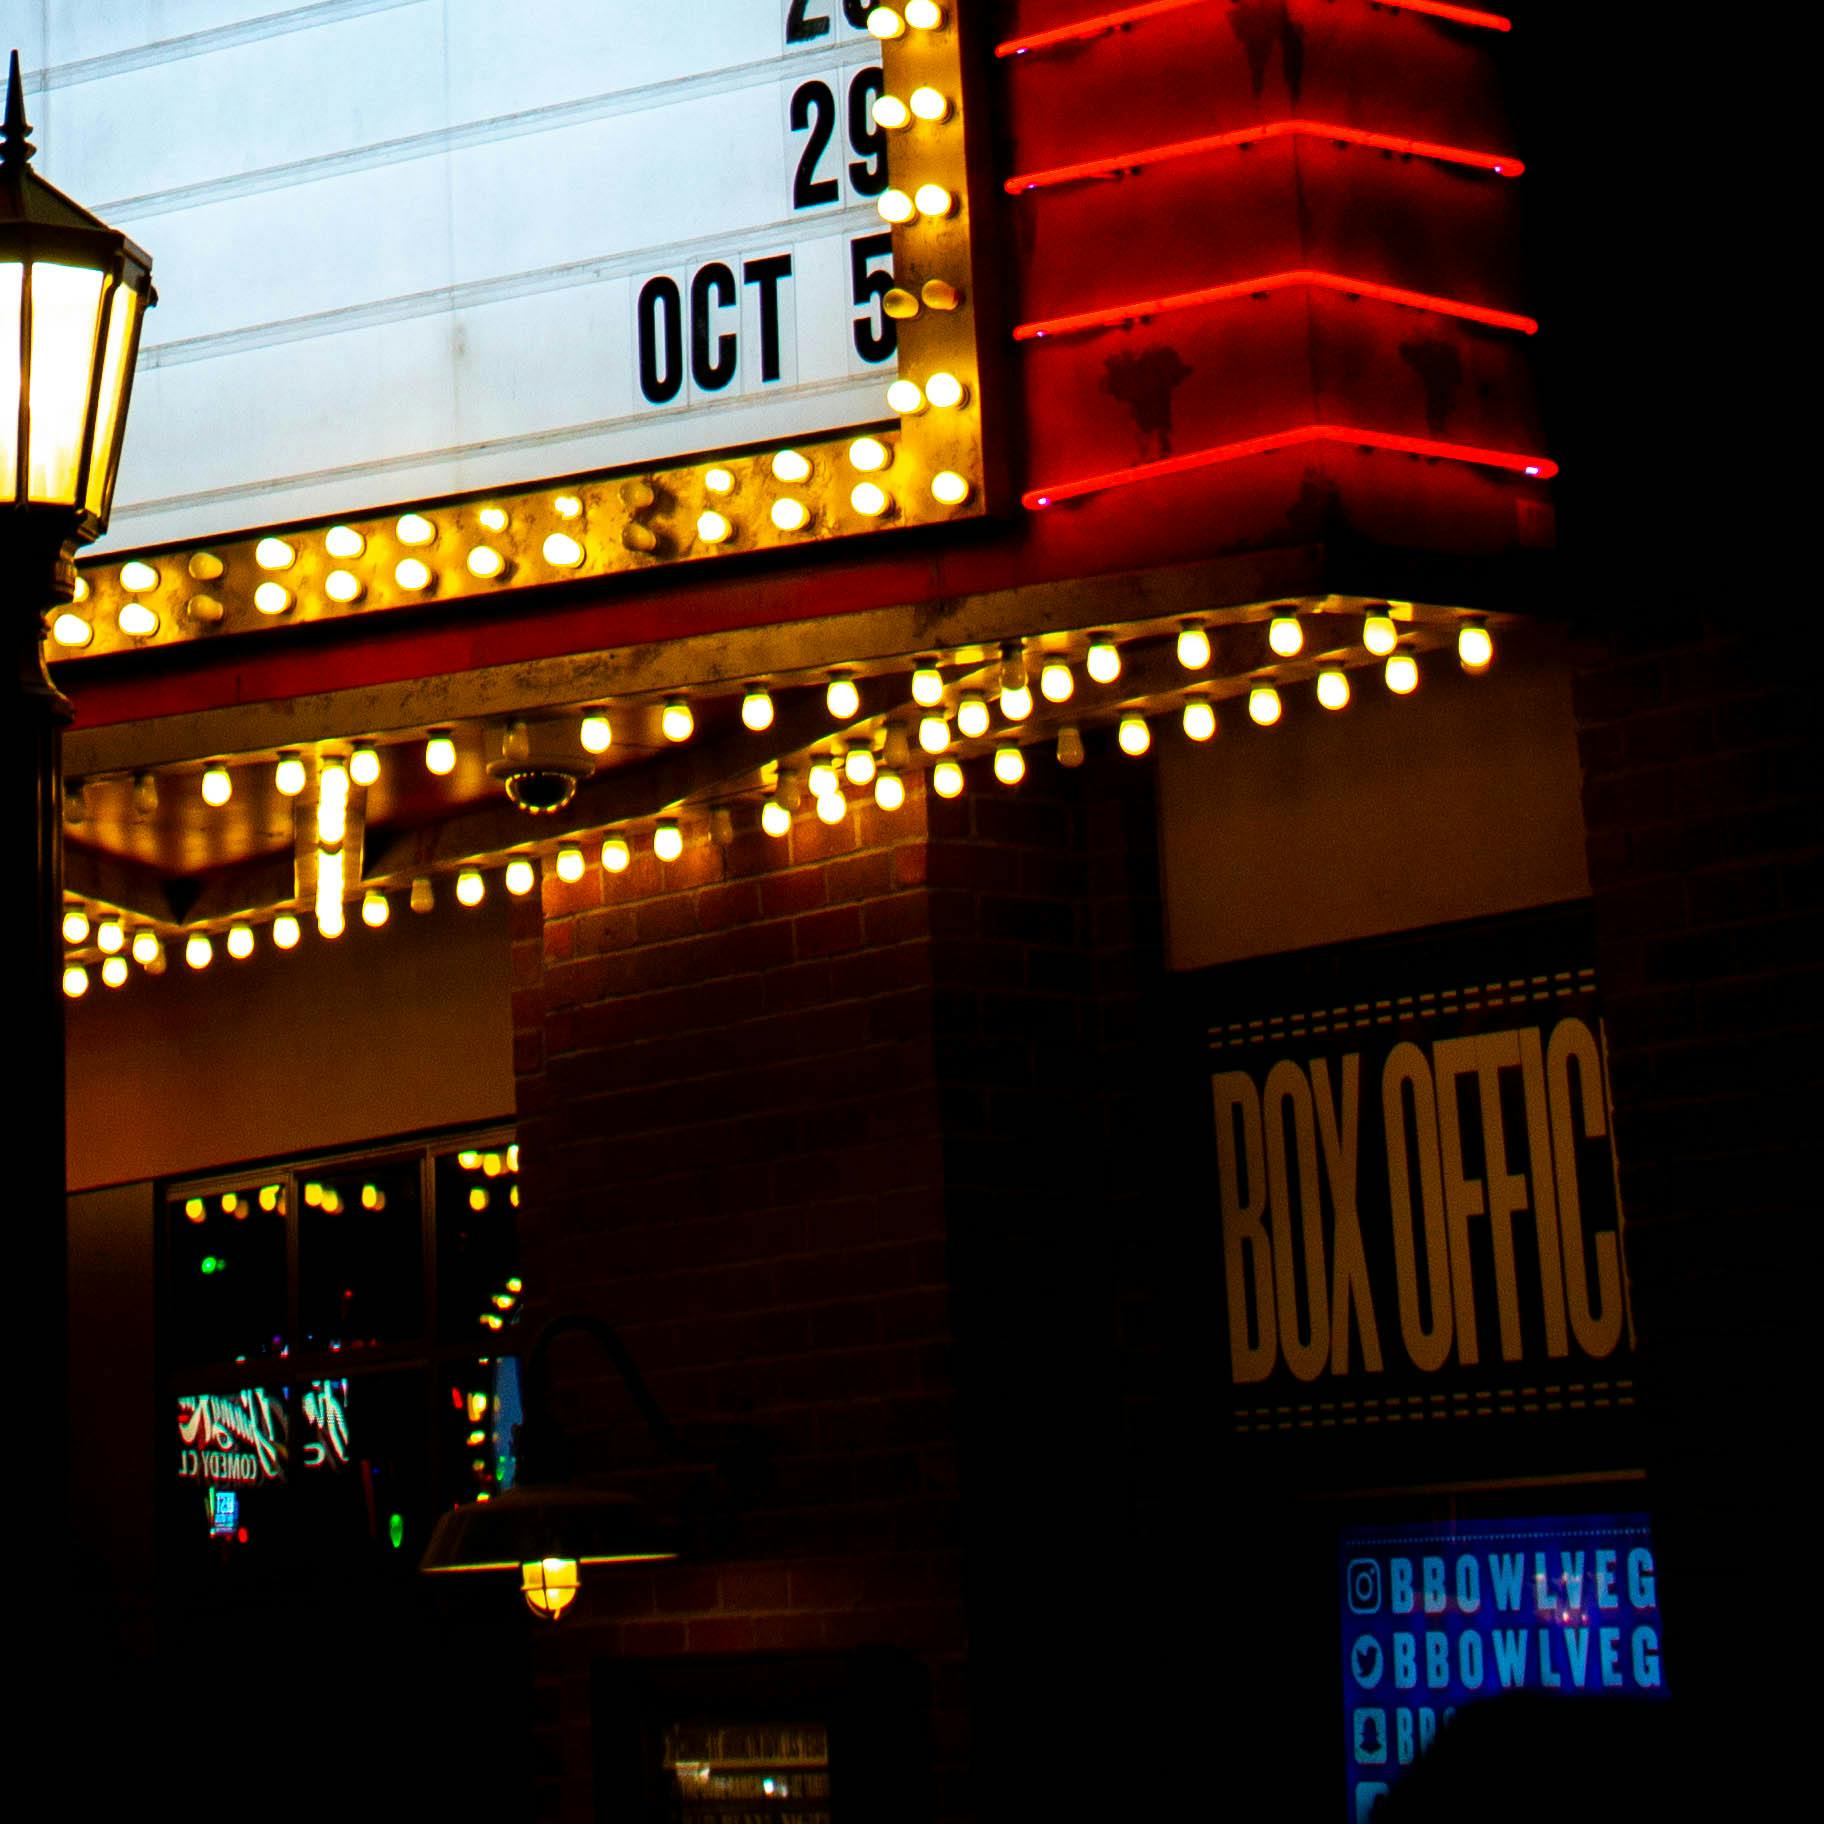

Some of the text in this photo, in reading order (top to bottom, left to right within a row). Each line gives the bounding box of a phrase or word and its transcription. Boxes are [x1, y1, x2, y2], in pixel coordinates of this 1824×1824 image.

[790, 66, 889, 210] 29
[637, 253, 792, 405] OCT
[851, 231, 899, 364] 5
[1210, 1015, 1637, 1386] BOX OFFIC
[1390, 1547, 1656, 1614] BBOWLVEG
[1393, 1626, 1661, 1689] BBOWLVEG
